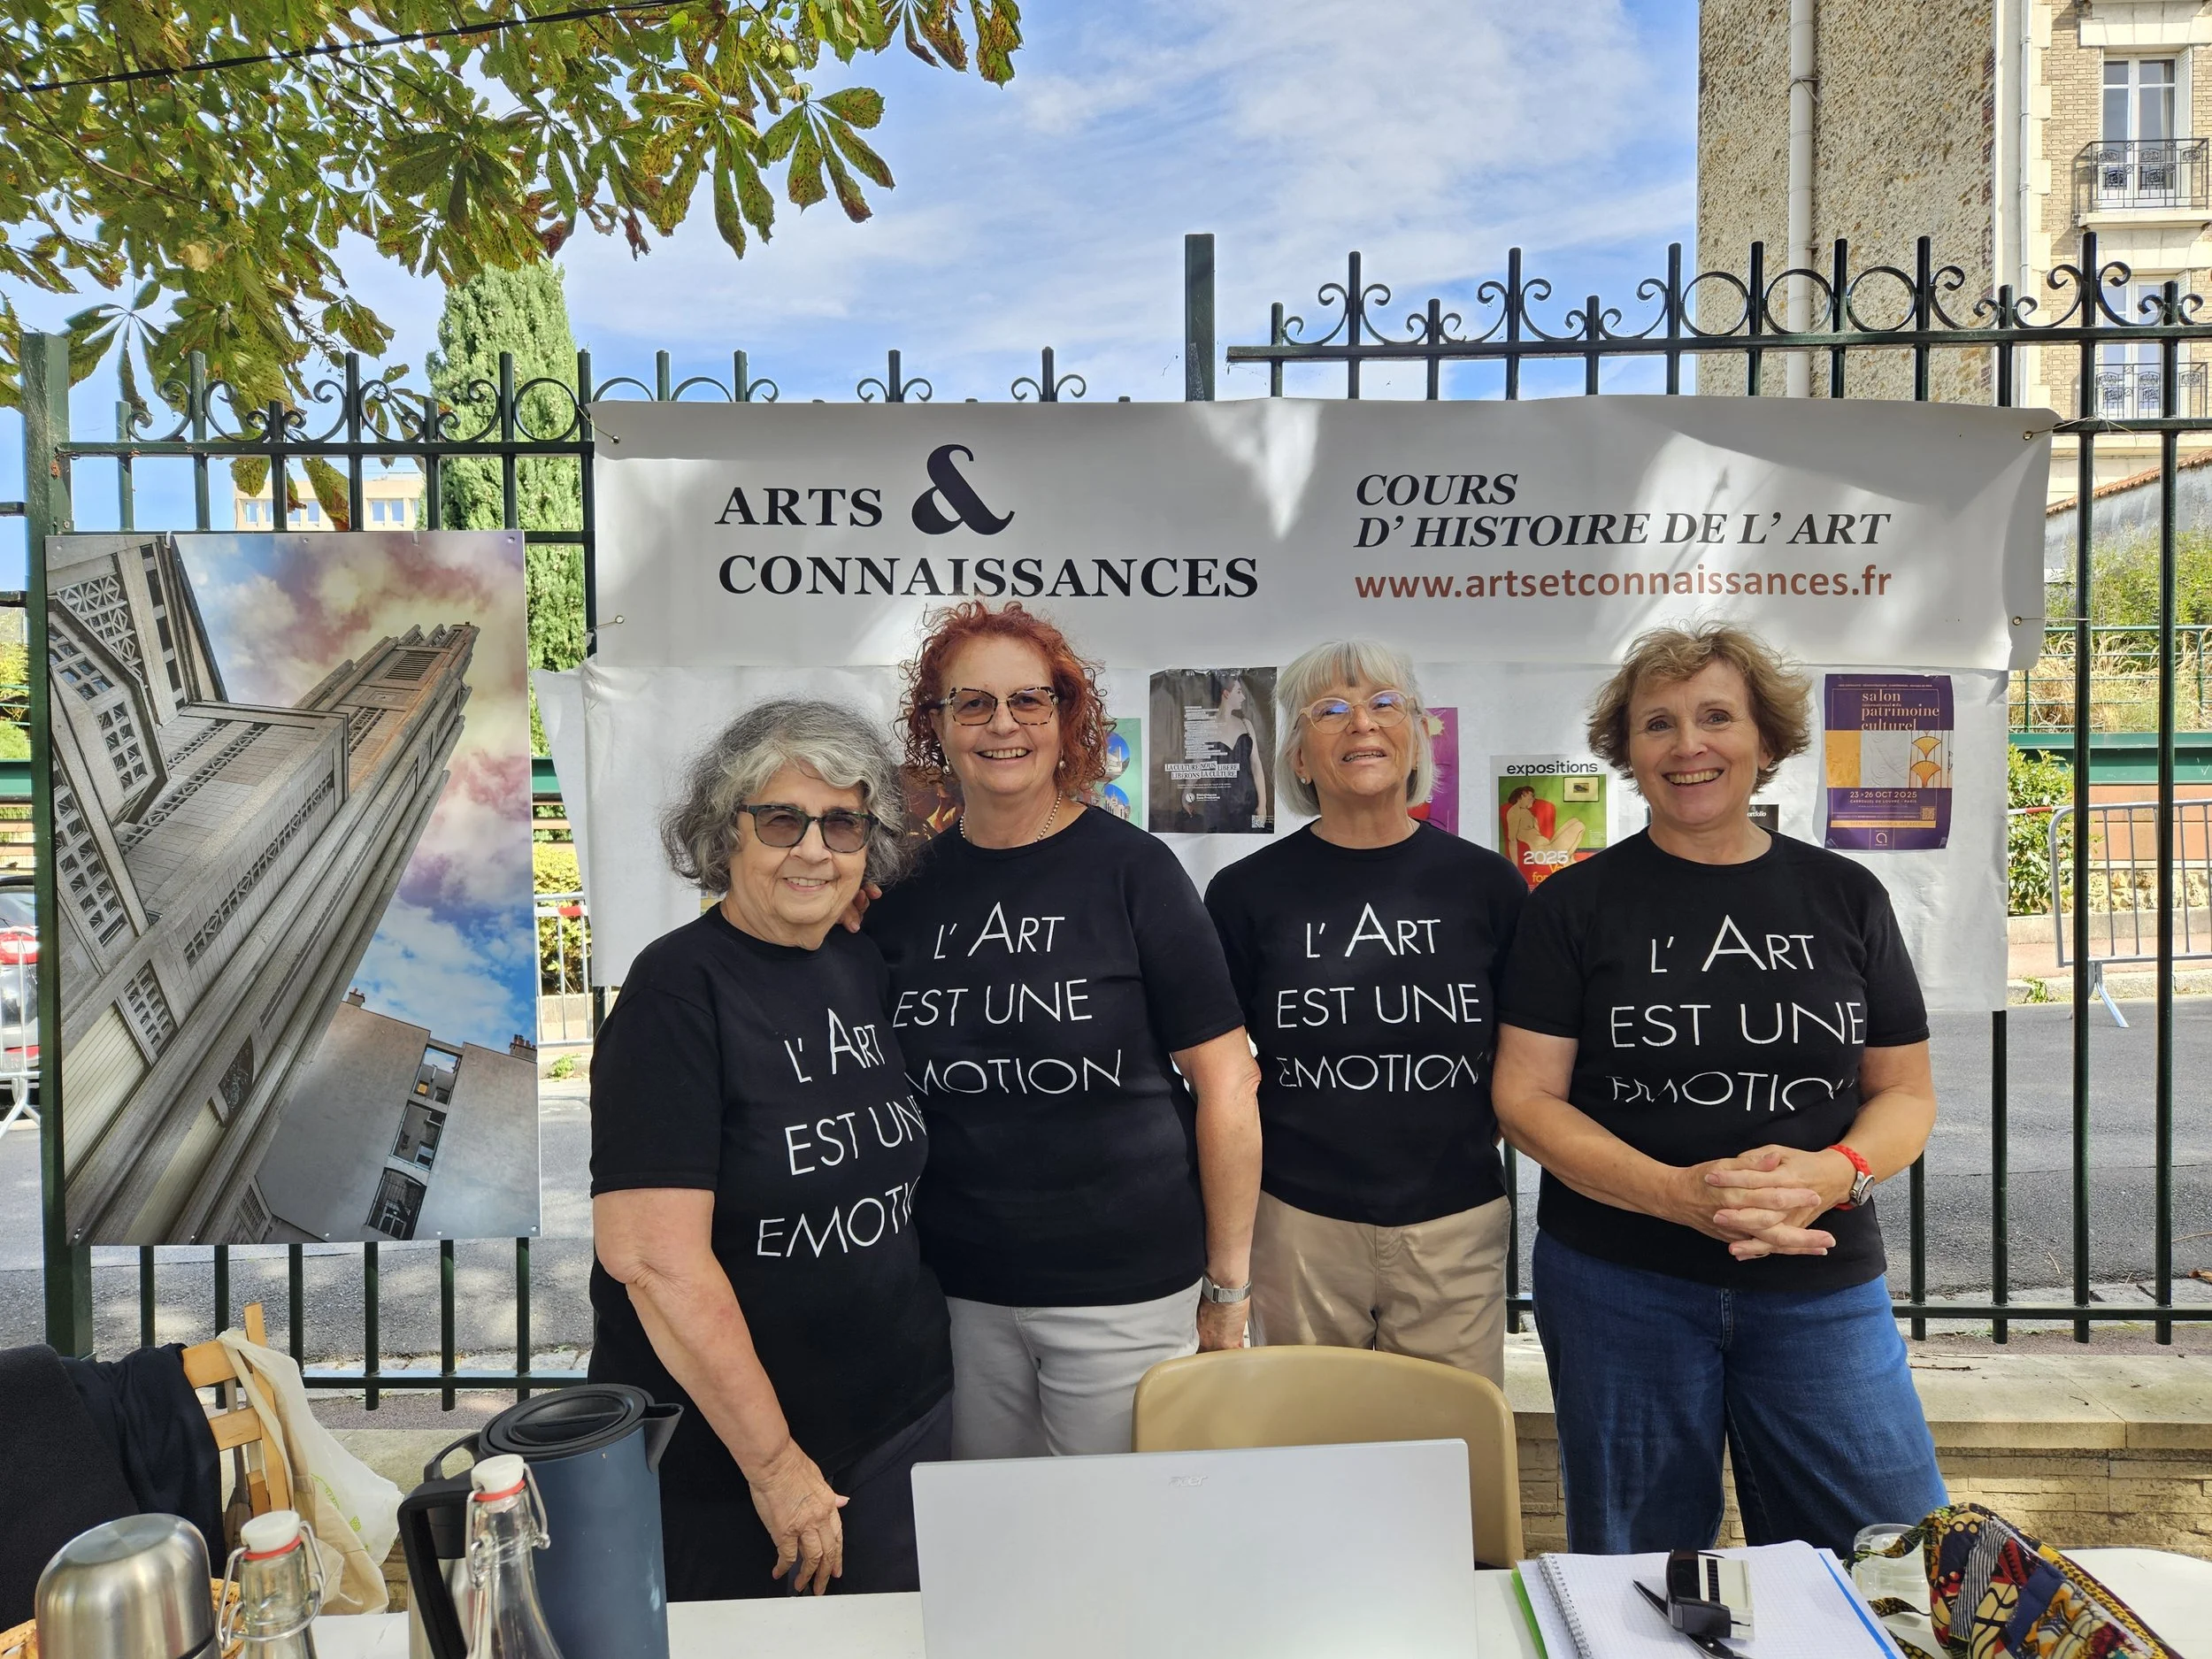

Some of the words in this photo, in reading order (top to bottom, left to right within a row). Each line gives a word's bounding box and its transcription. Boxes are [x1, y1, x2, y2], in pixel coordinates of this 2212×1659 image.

[715, 487, 883, 527] ARTS
[911, 443, 1016, 535] &
[1356, 473, 1518, 506] COURS
[1659, 512, 1728, 545] DE
[718, 554, 1259, 598] CONNAISSANCES
[1355, 564, 1893, 598] www.artsetconnaissances.fr
[1861, 703, 1939, 721] patrimoine
[1862, 688, 1901, 702] salon
[1861, 718, 1916, 731] culturel
[1507, 761, 1598, 776] expositions
[1523, 850, 1569, 865] 2025
[892, 987, 969, 1028] EST
[985, 978, 1093, 1025] UNE
[1277, 987, 1356, 1029] EST
[1375, 983, 1482, 1024] UNE
[1610, 1003, 1712, 1048] EST
[1740, 1002, 1865, 1045] UNE
[903, 1048, 1122, 1096] MOTION
[784, 1111, 858, 1176] EST
[868, 1094, 927, 1148] UN
[757, 1175, 921, 1259] EMOTI
